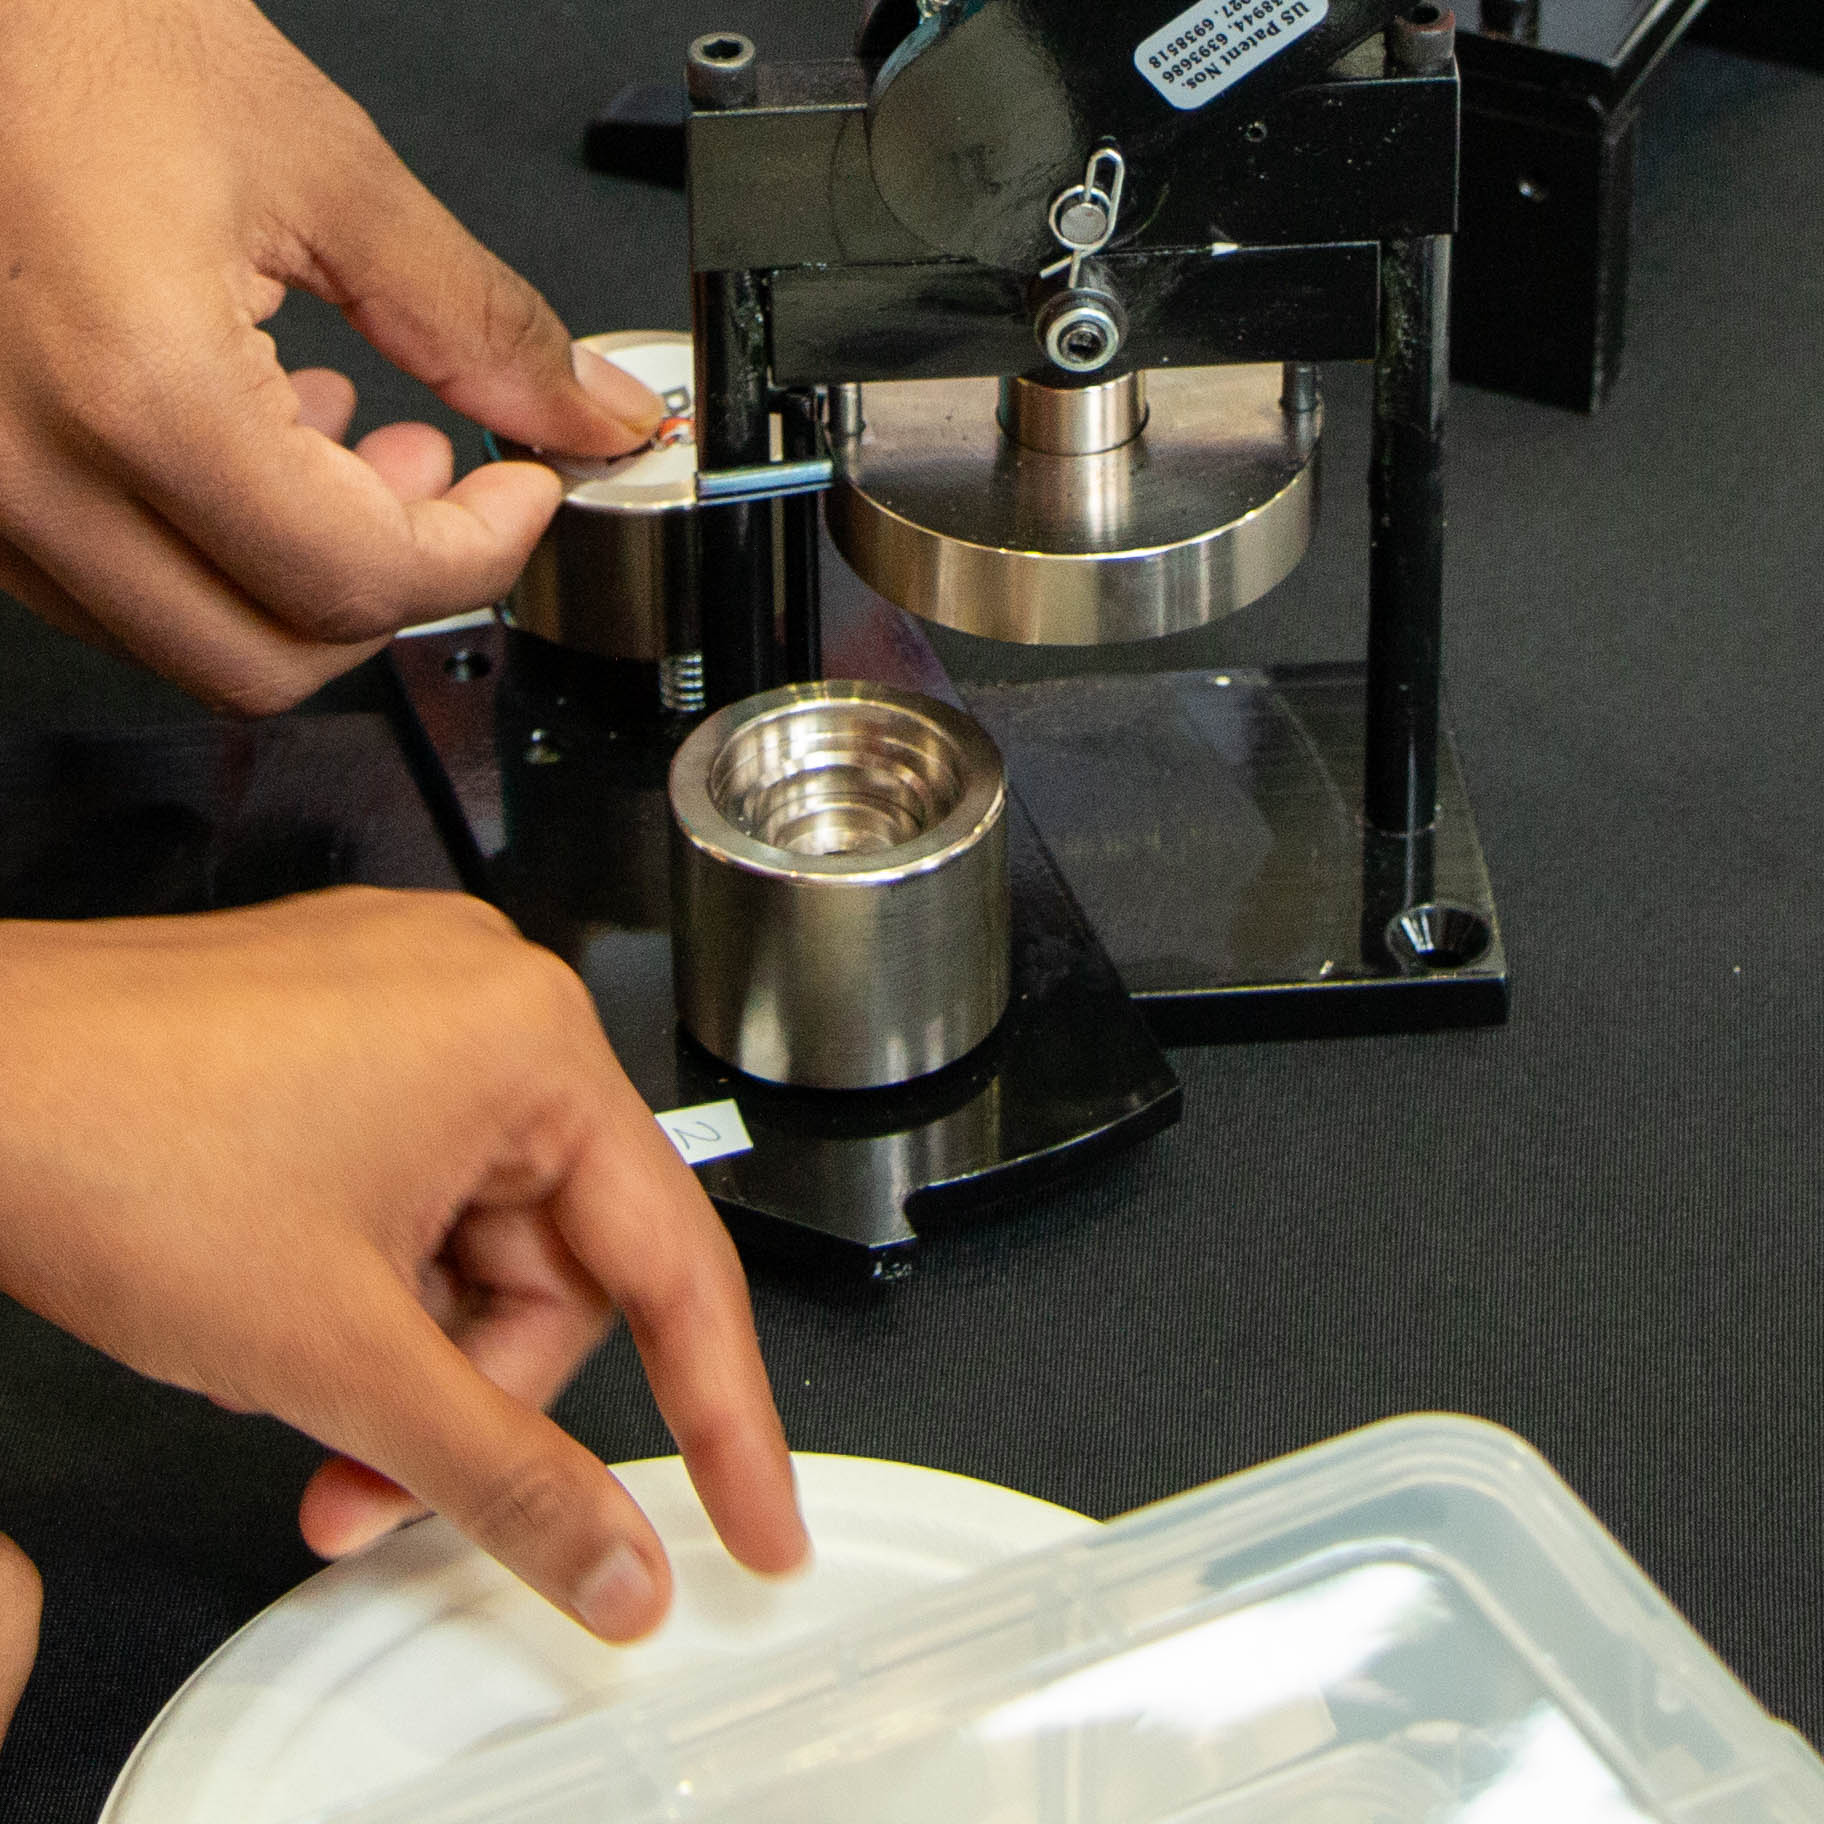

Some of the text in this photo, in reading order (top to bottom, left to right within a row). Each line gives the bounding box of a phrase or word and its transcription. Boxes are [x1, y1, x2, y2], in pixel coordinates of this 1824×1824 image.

[1148, 18, 1215, 69] 6938518
[1162, 33, 1229, 84] 6393686
[1181, 0, 1310, 90] US Patent Nos.
[672, 1121, 721, 1150] 2
